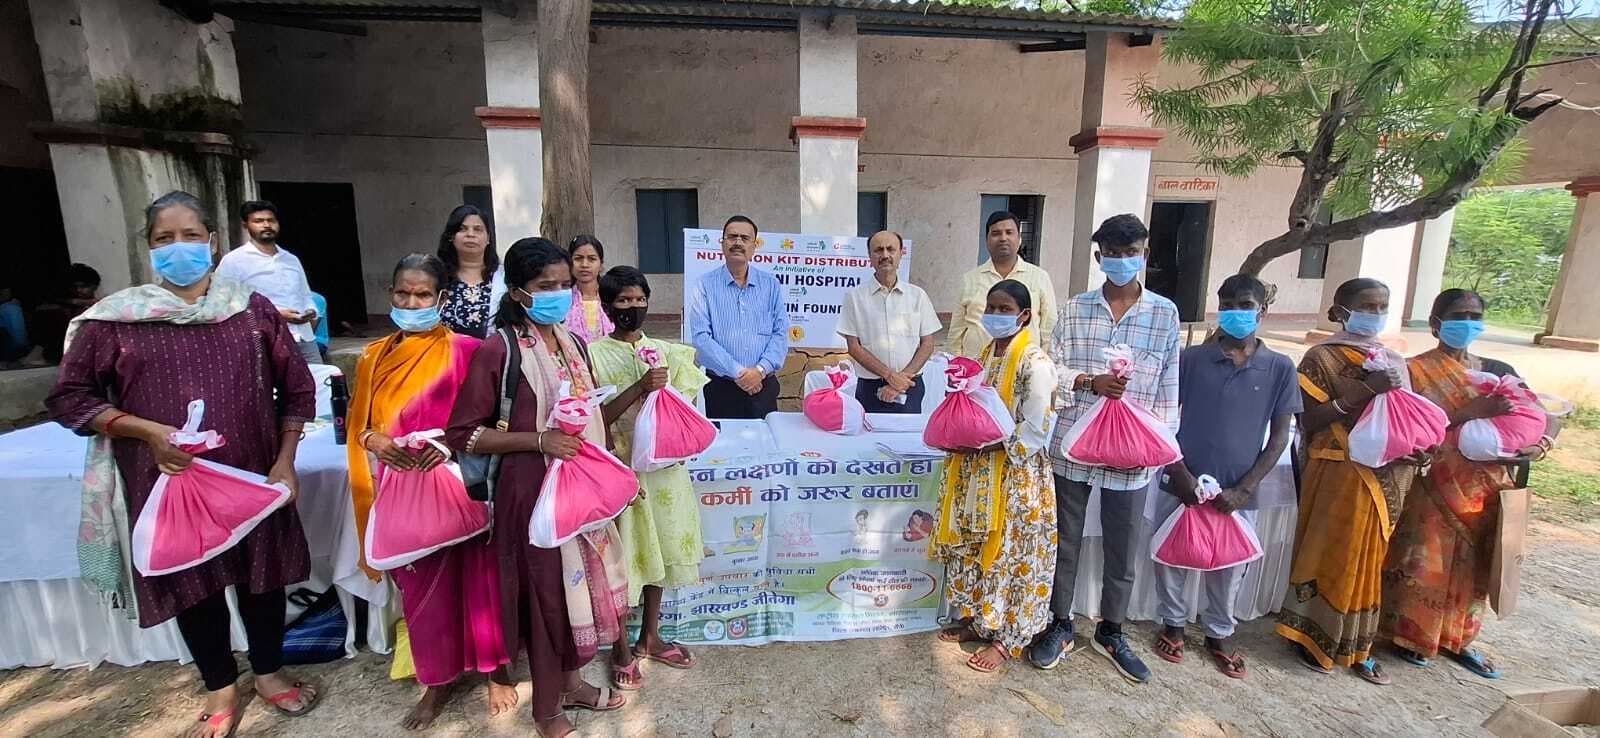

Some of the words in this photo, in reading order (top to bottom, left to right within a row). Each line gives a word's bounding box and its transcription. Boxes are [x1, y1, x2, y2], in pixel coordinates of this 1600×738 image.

[696, 252, 773, 263] NUTON
[777, 256, 800, 265] KIT
[786, 265, 816, 273] Initiative
[776, 274, 789, 285] NI
[784, 302, 799, 313] IN
[724, 459, 800, 481] लक्षणों
[700, 486, 752, 506] कर्मी
[760, 484, 790, 502] को
[751, 591, 796, 606] जीतेगा
